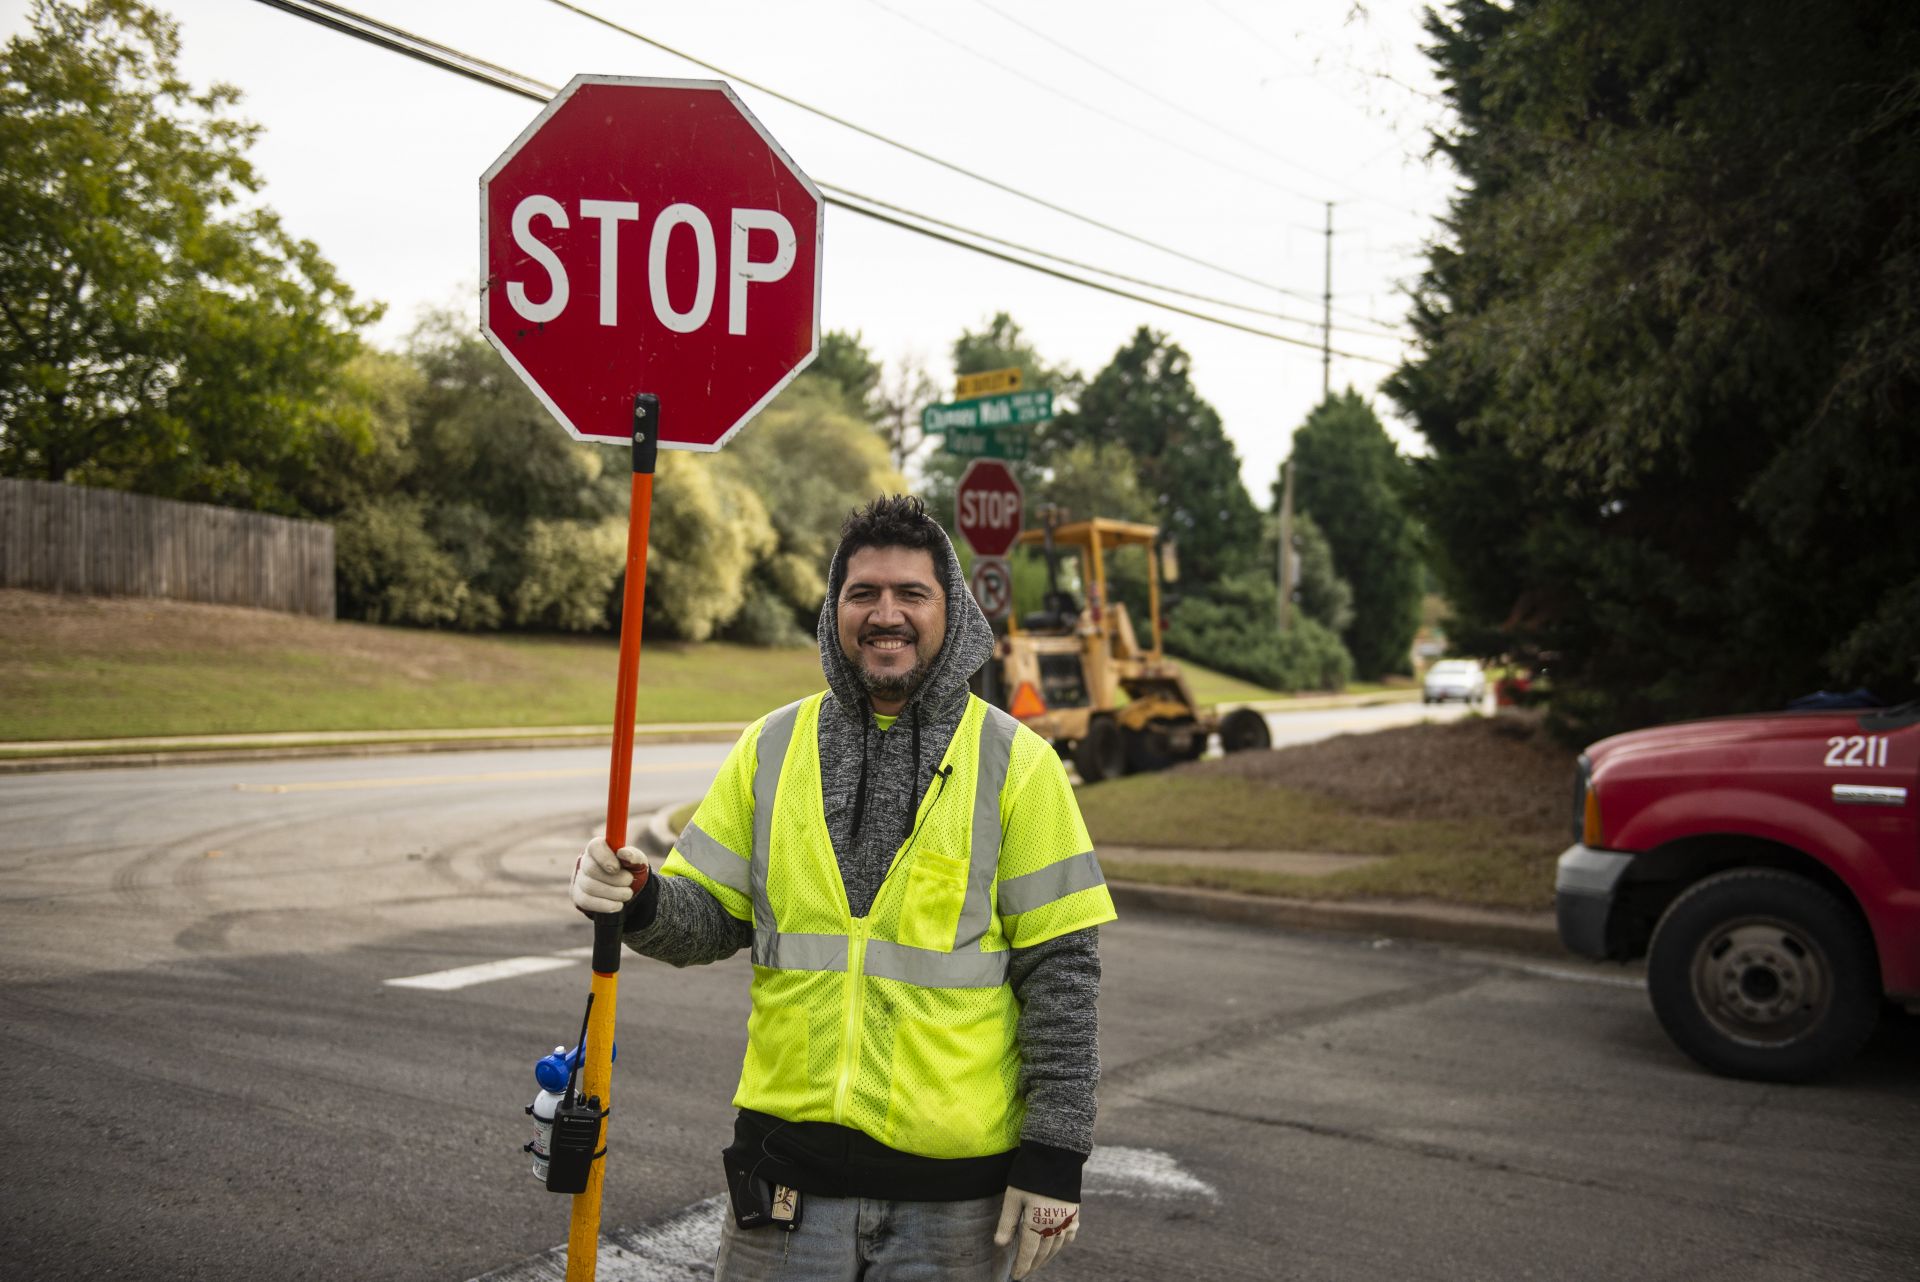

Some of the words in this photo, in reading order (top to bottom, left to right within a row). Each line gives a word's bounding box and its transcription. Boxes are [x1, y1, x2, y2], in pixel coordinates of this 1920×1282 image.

[506, 194, 797, 335] STOP
[961, 490, 1018, 529] STOP
[1824, 735, 1889, 767] 2211
[1033, 1207, 1067, 1217] HARE
[1033, 1216, 1054, 1225] RED
